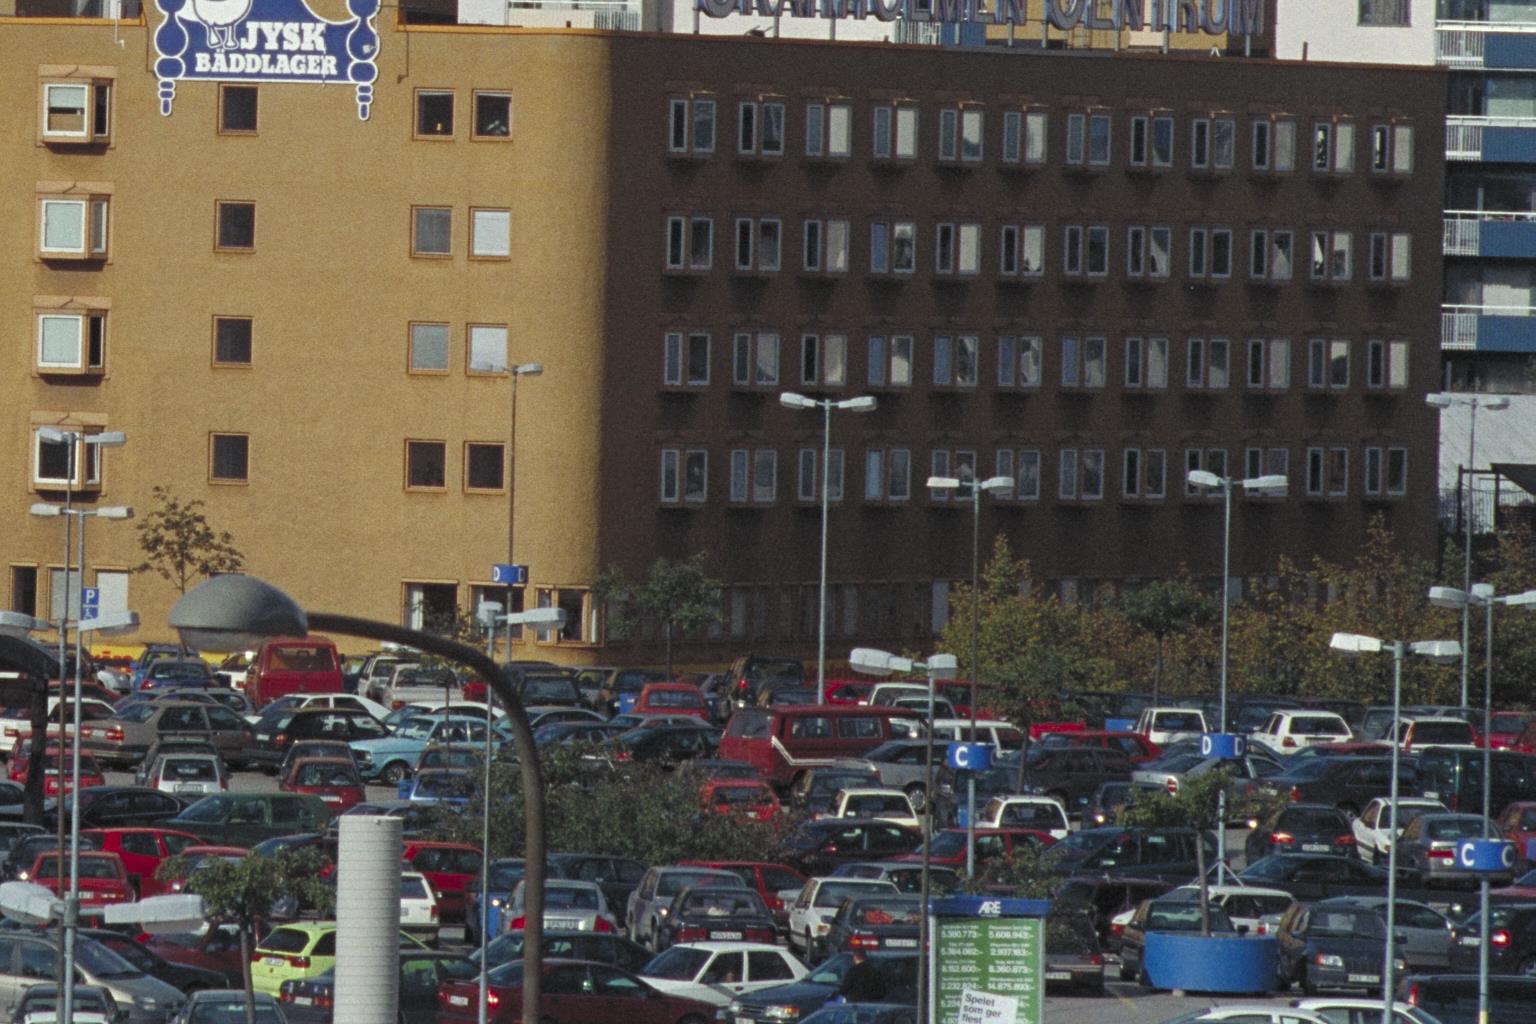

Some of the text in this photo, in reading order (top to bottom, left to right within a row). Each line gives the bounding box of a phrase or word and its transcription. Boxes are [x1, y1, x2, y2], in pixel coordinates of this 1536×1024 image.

[240, 22, 326, 52] JYSK
[195, 47, 337, 76] BÄDDLAGER
[493, 566, 501, 581] D
[86, 589, 96, 603] P
[1201, 735, 1211, 755] D
[1234, 736, 1243, 756] D
[955, 746, 969, 767] C
[1461, 843, 1474, 867] C
[1501, 845, 1513, 867] C
[965, 993, 995, 1007] Spelet
[963, 1005, 1002, 1018] som ger
